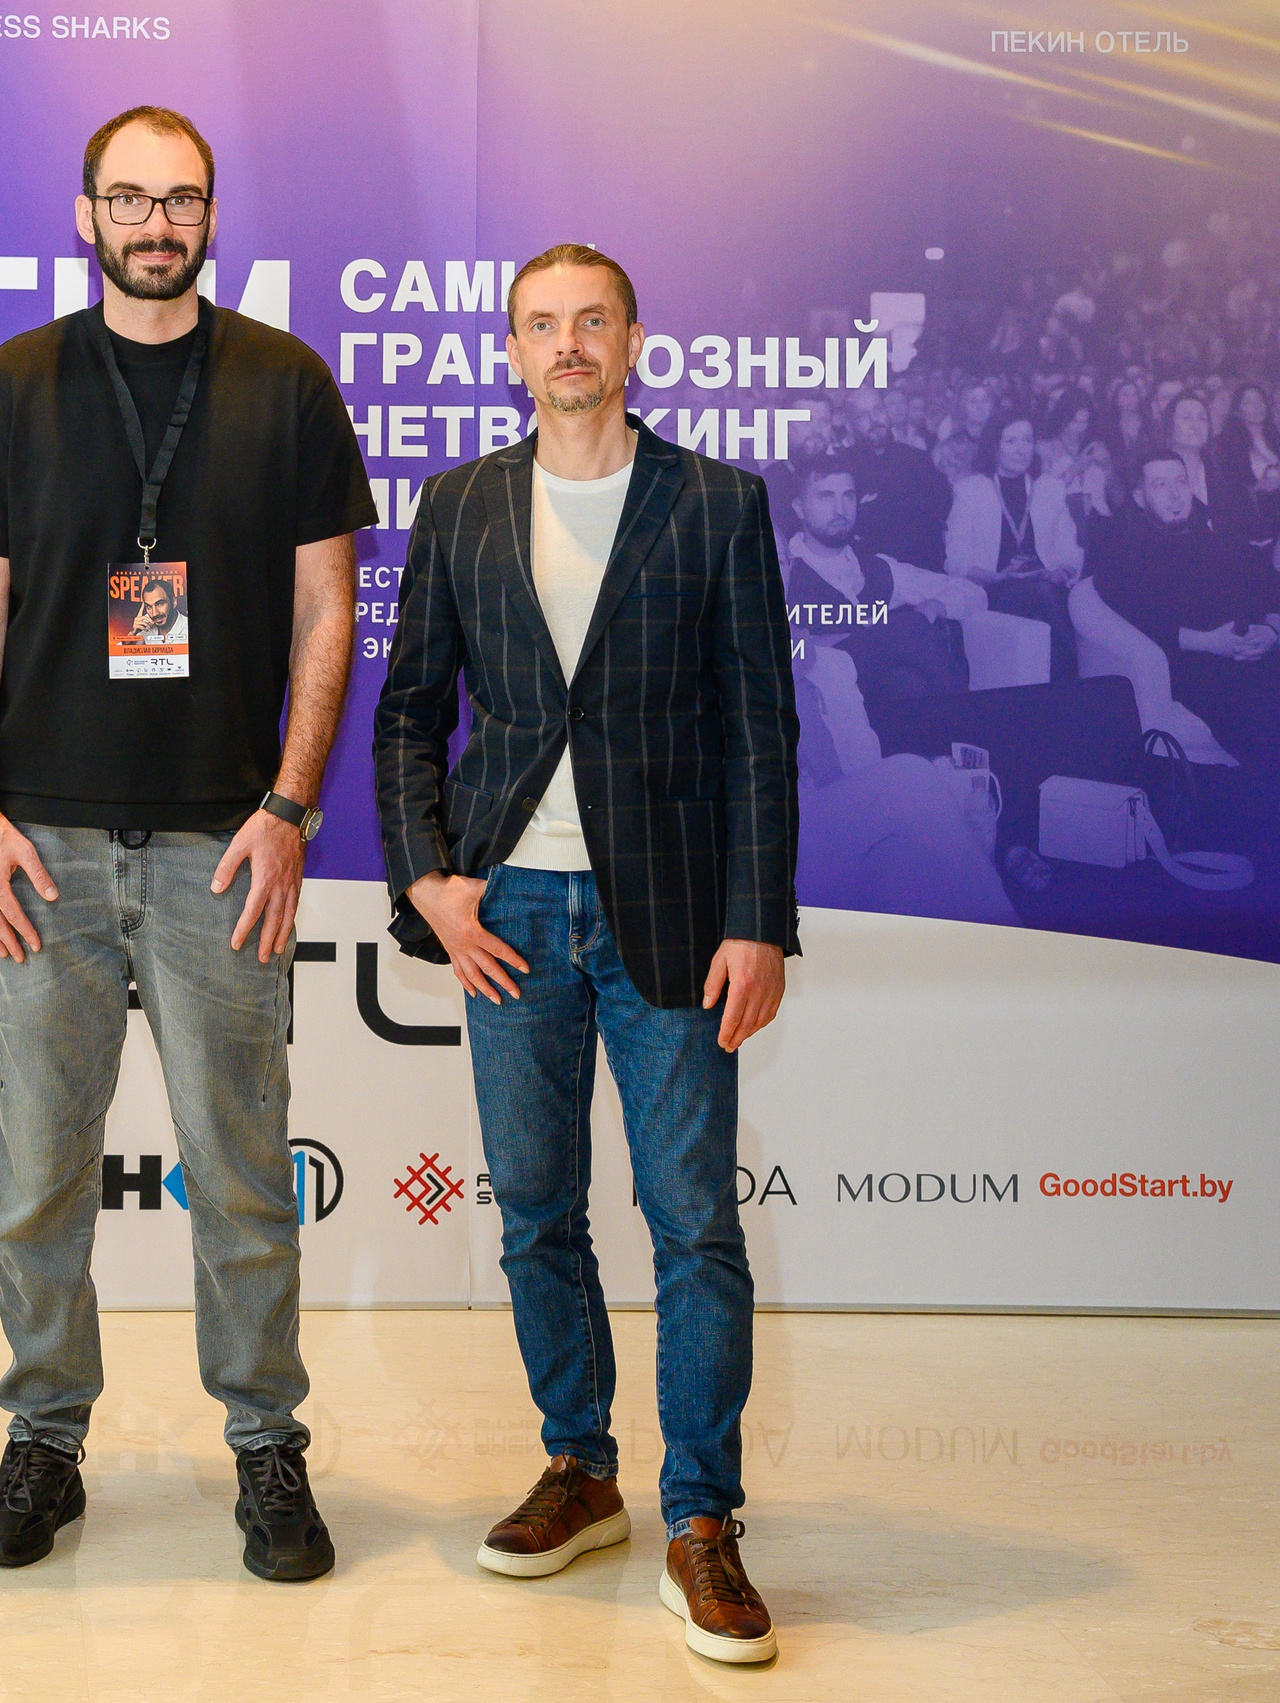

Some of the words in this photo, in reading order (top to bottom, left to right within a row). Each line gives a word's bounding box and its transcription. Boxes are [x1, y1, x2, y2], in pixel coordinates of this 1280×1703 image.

[51, 15, 171, 40] SHARKS
[991, 30, 1084, 53] ПЕКИН
[1095, 30, 1189, 54] ОТЕЛЬ
[340, 319, 888, 390] ГРАНОЗНЫЙ
[109, 574, 185, 602] SPER
[151, 658, 174, 666] RTL
[837, 1172, 1019, 1204] MODUM
[1039, 1172, 1234, 1204] GoodStart.by
